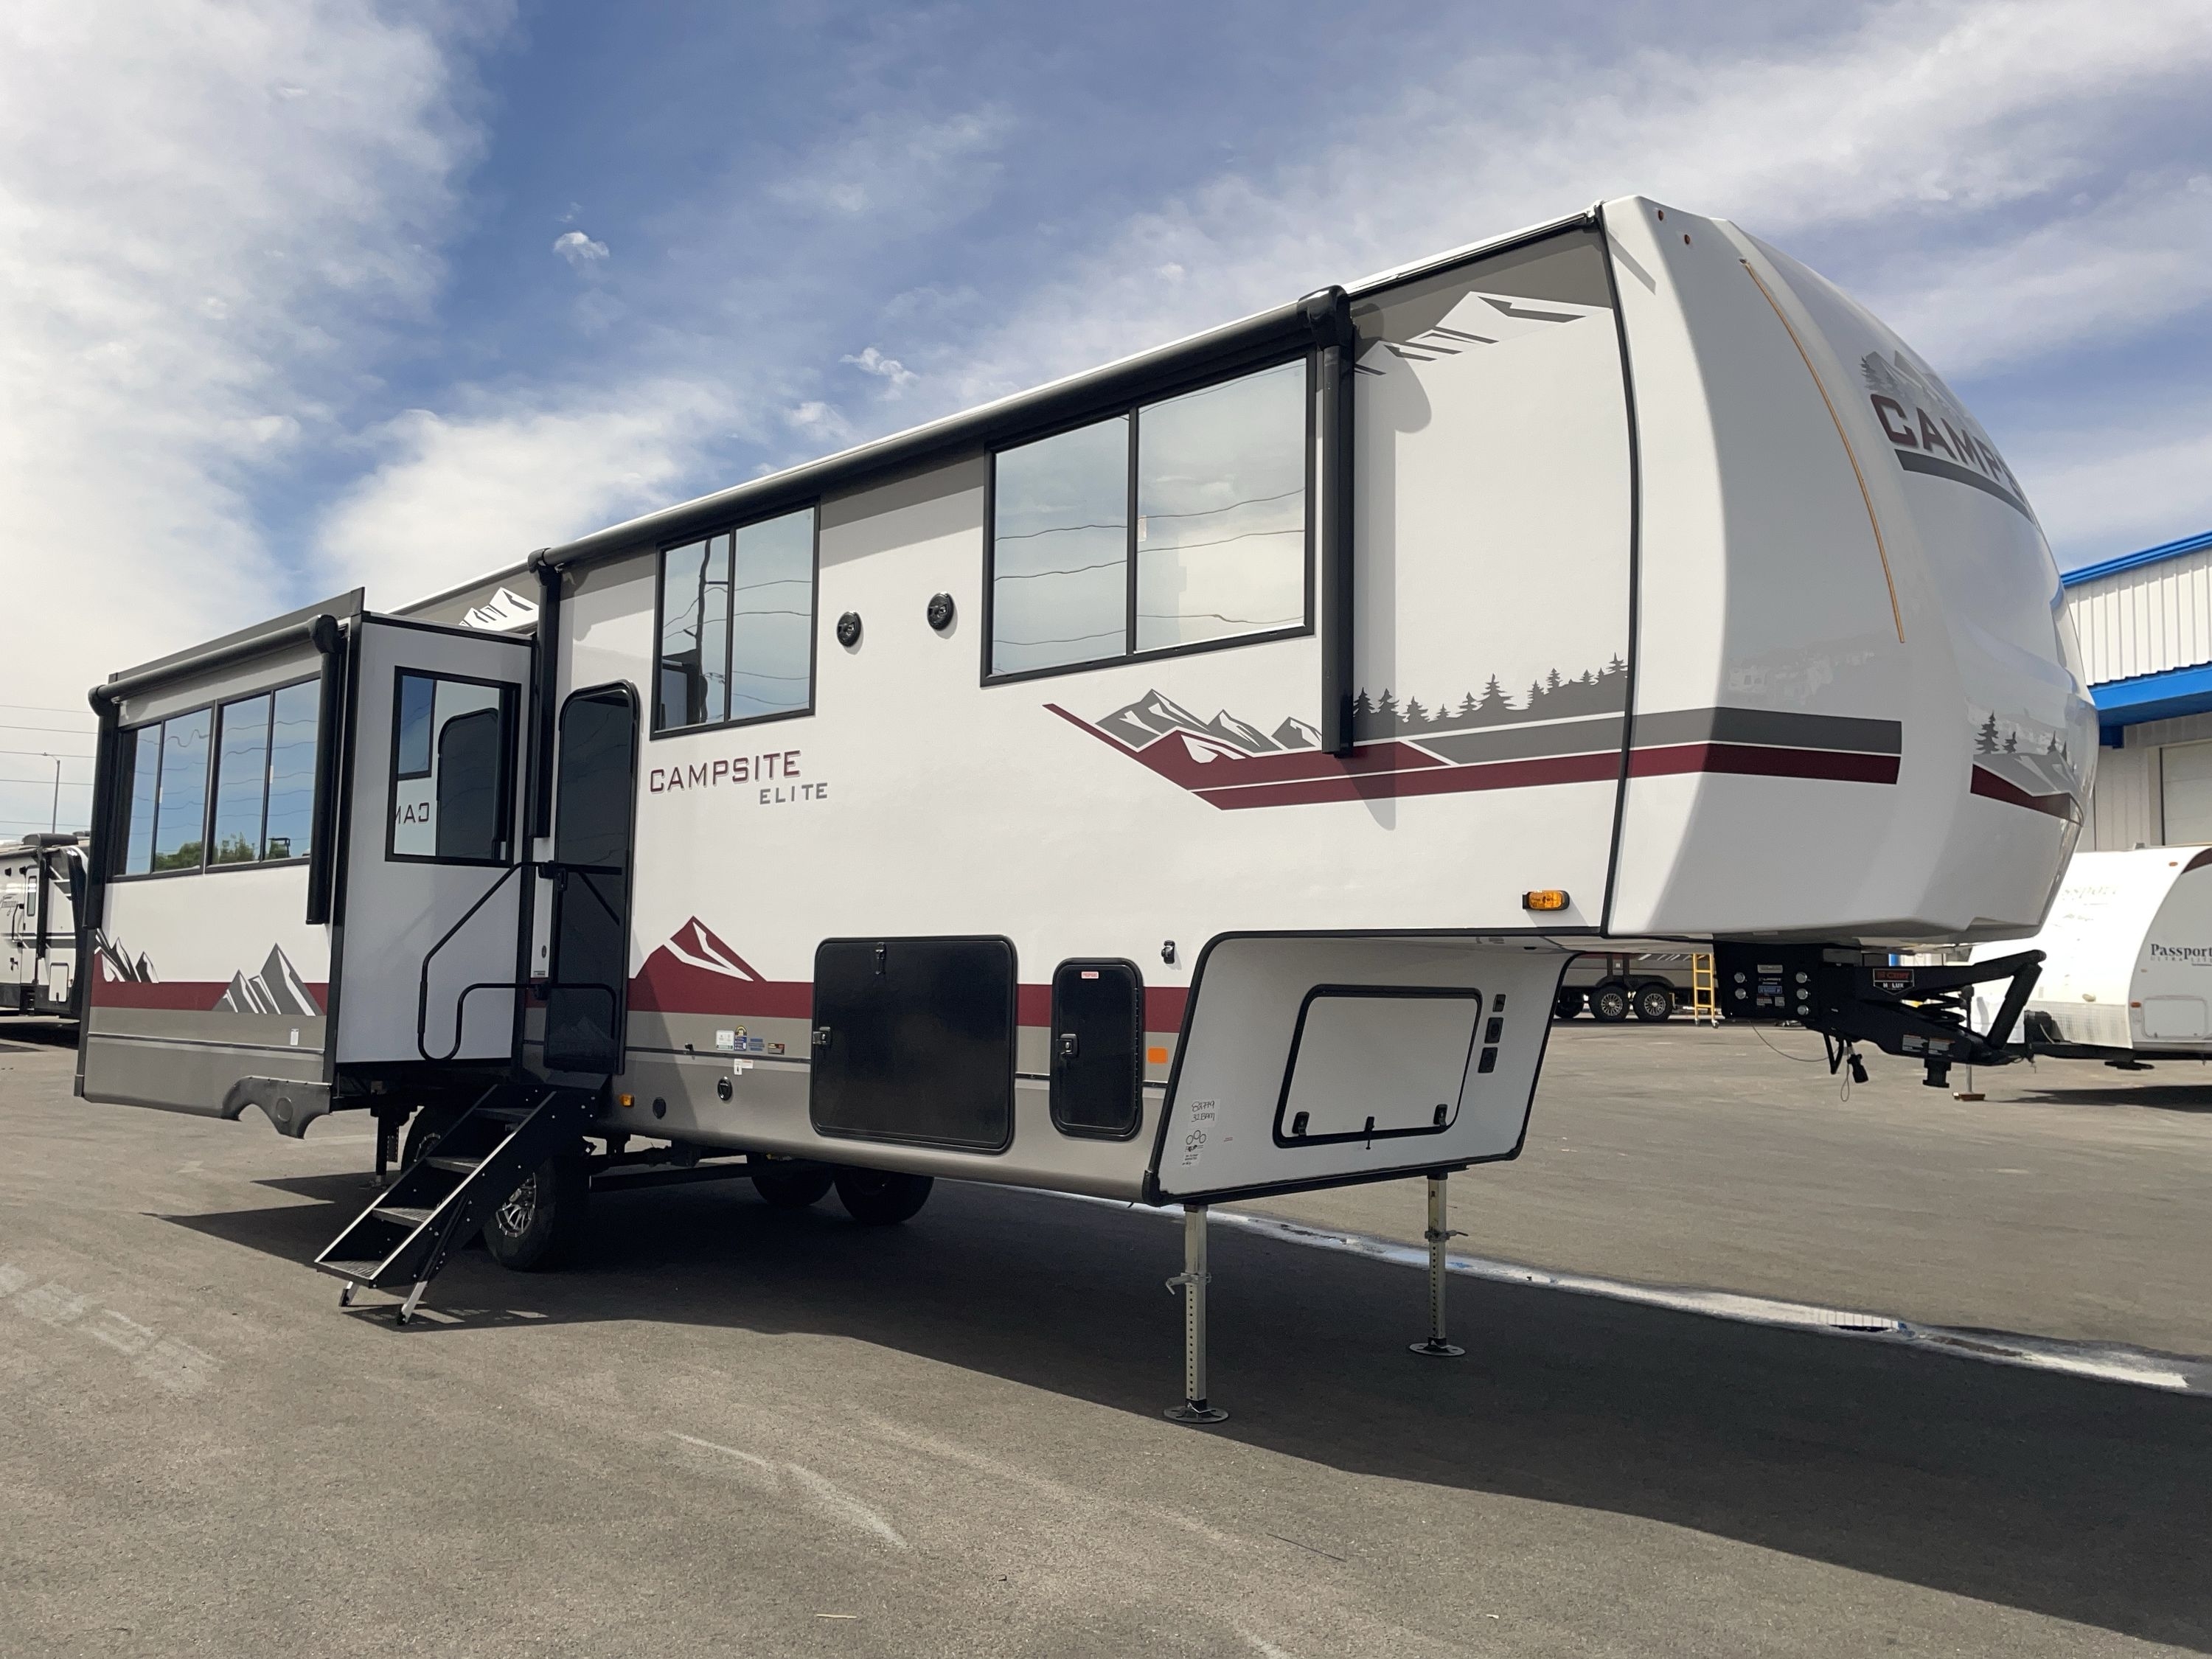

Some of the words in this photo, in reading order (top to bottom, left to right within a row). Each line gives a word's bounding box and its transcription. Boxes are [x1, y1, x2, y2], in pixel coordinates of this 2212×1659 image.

[650, 749, 801, 794] CAMPSITE
[759, 782, 828, 805] ELITE
[2151, 944, 2212, 960] Passport
